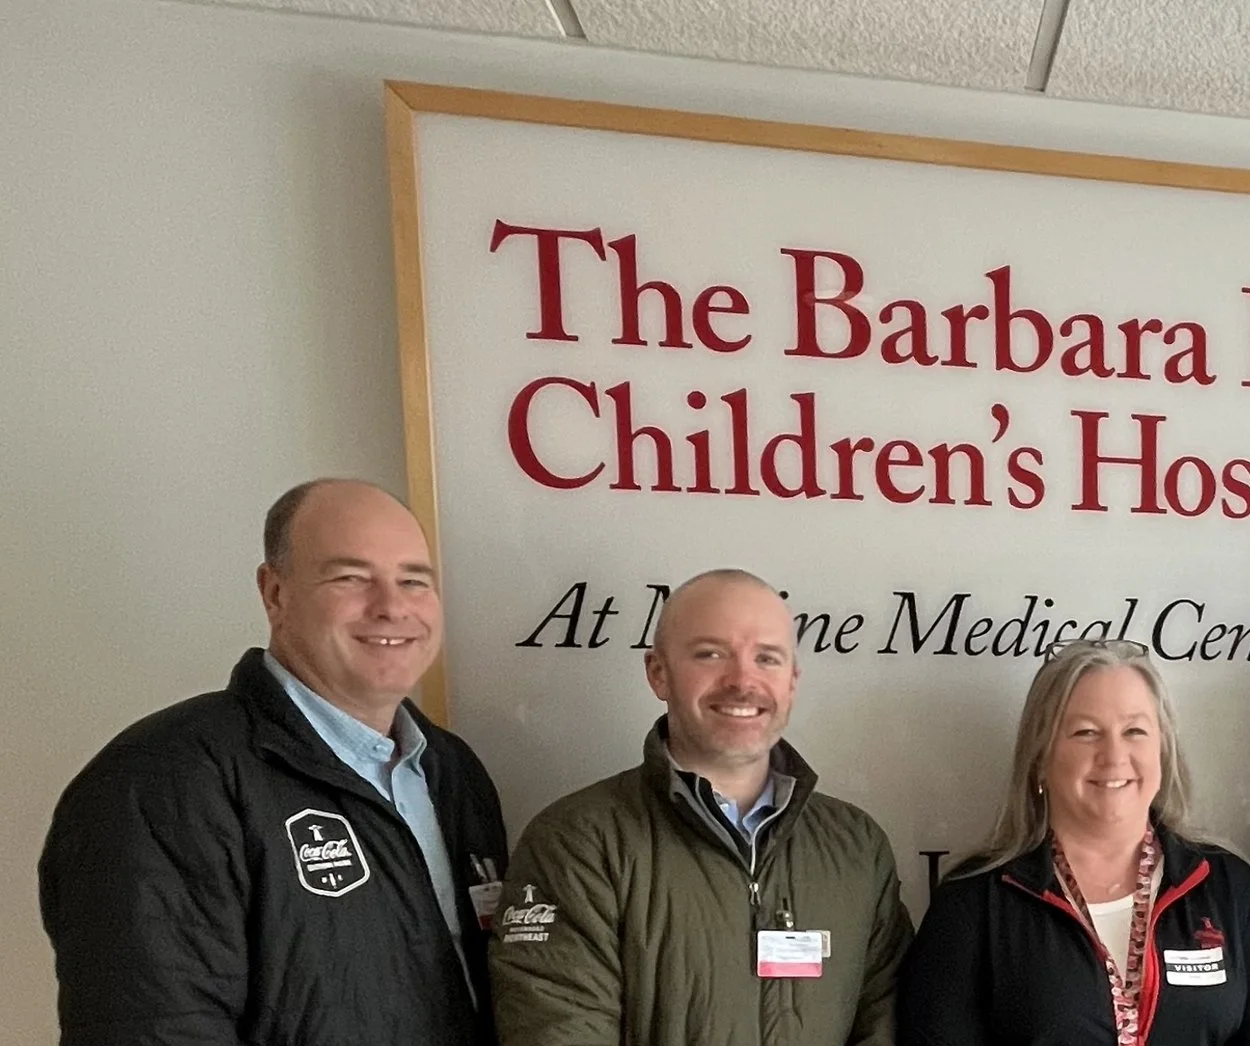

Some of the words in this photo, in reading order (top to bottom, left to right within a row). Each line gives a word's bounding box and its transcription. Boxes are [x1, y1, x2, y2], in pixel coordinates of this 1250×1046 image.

[490, 218, 752, 354] The
[784, 247, 1215, 386] Barbara
[507, 377, 1046, 510] Children's
[514, 580, 620, 650] At
[1174, 962, 1219, 972] VISITOR
